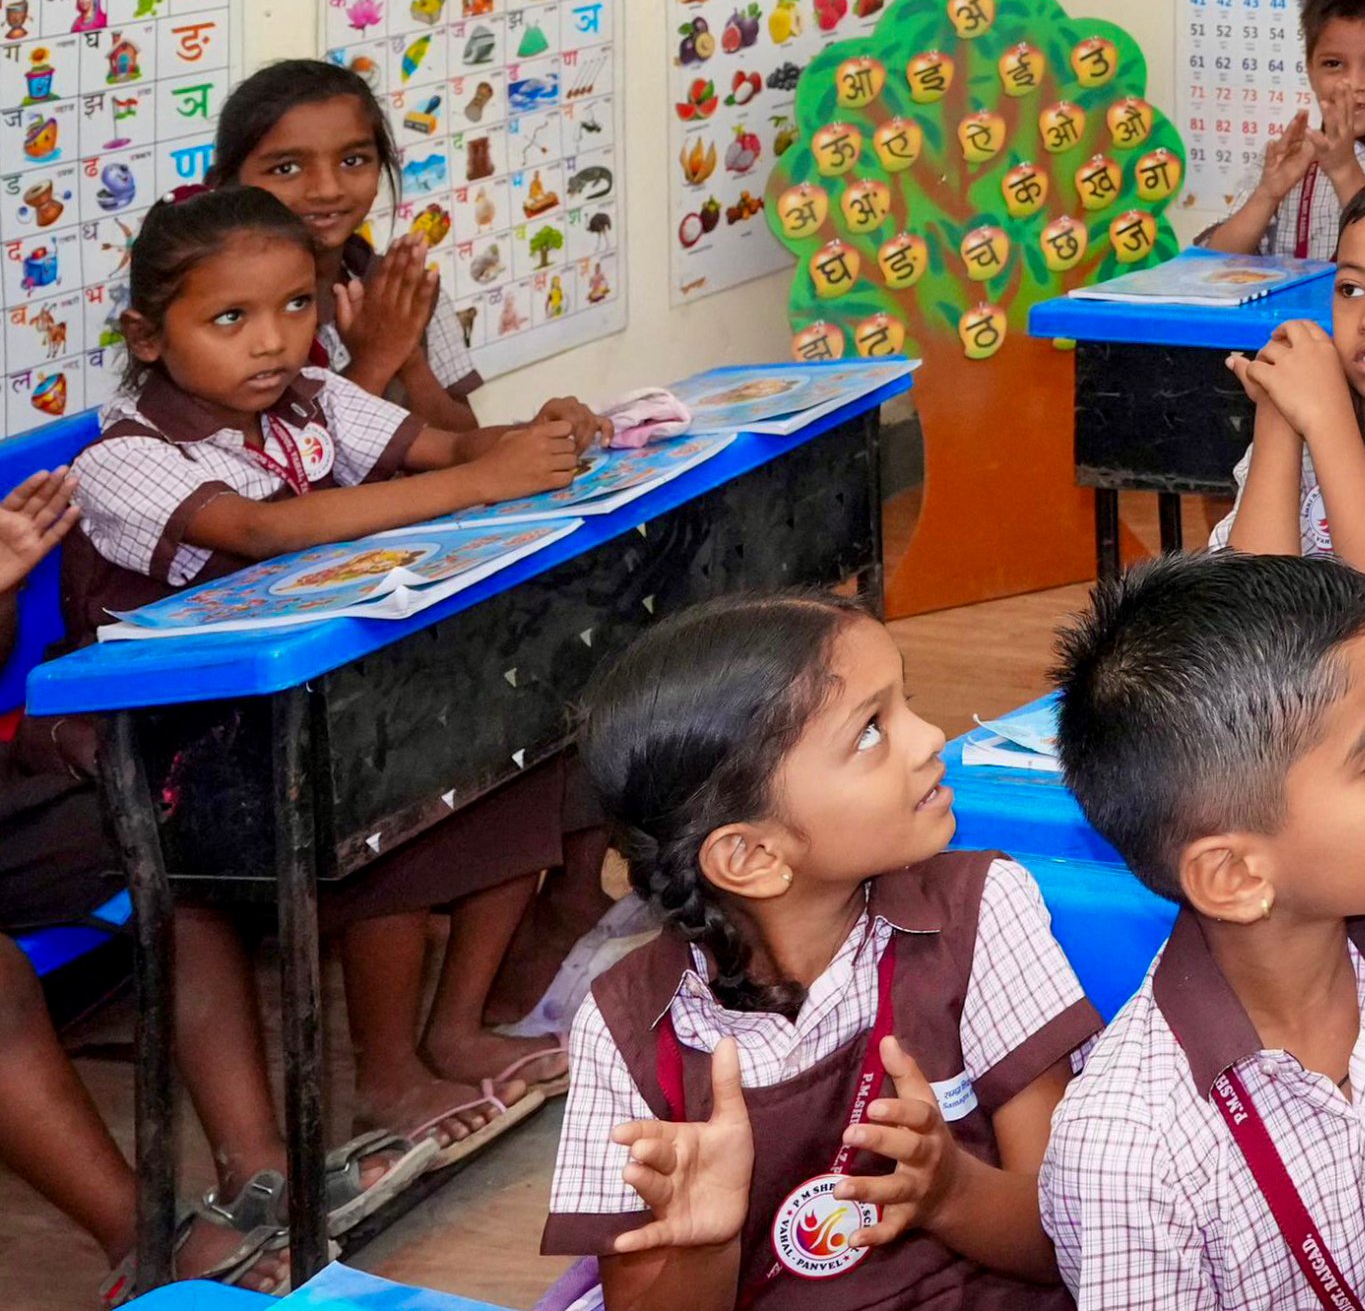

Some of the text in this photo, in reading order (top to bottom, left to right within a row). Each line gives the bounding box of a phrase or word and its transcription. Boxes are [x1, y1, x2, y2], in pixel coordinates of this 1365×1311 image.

[1080, 47, 1109, 77] उ
[843, 66, 874, 100] आ
[1141, 159, 1170, 190] ग
[1215, 1076, 1248, 1125] P.M.SH
[780, 1219, 844, 1271] VAHAL PANVEL
